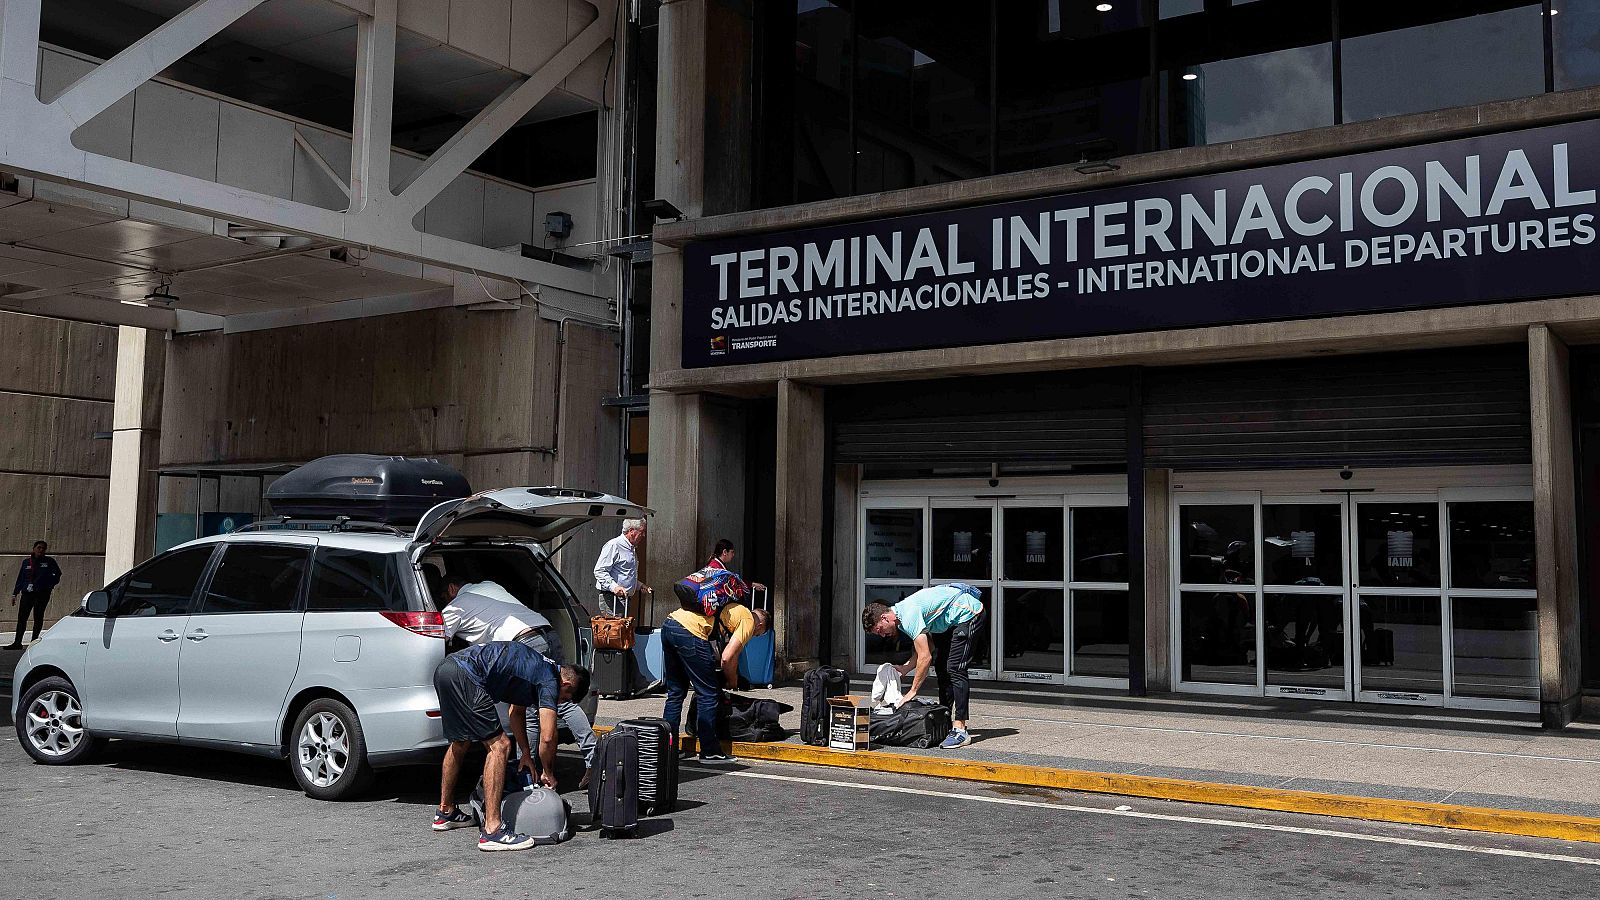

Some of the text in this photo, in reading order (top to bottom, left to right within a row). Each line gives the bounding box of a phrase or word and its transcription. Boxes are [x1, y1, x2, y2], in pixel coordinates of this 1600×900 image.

[710, 142, 1597, 301] TERMINAL INTERNACIONAL
[710, 298, 803, 330] SALIDAS
[808, 273, 1050, 320] INTERNACIONALES
[1078, 242, 1336, 295] INTERNATIONAL
[1344, 213, 1596, 269] DEPARTURES
[731, 339, 777, 350] TRANSPORTE
